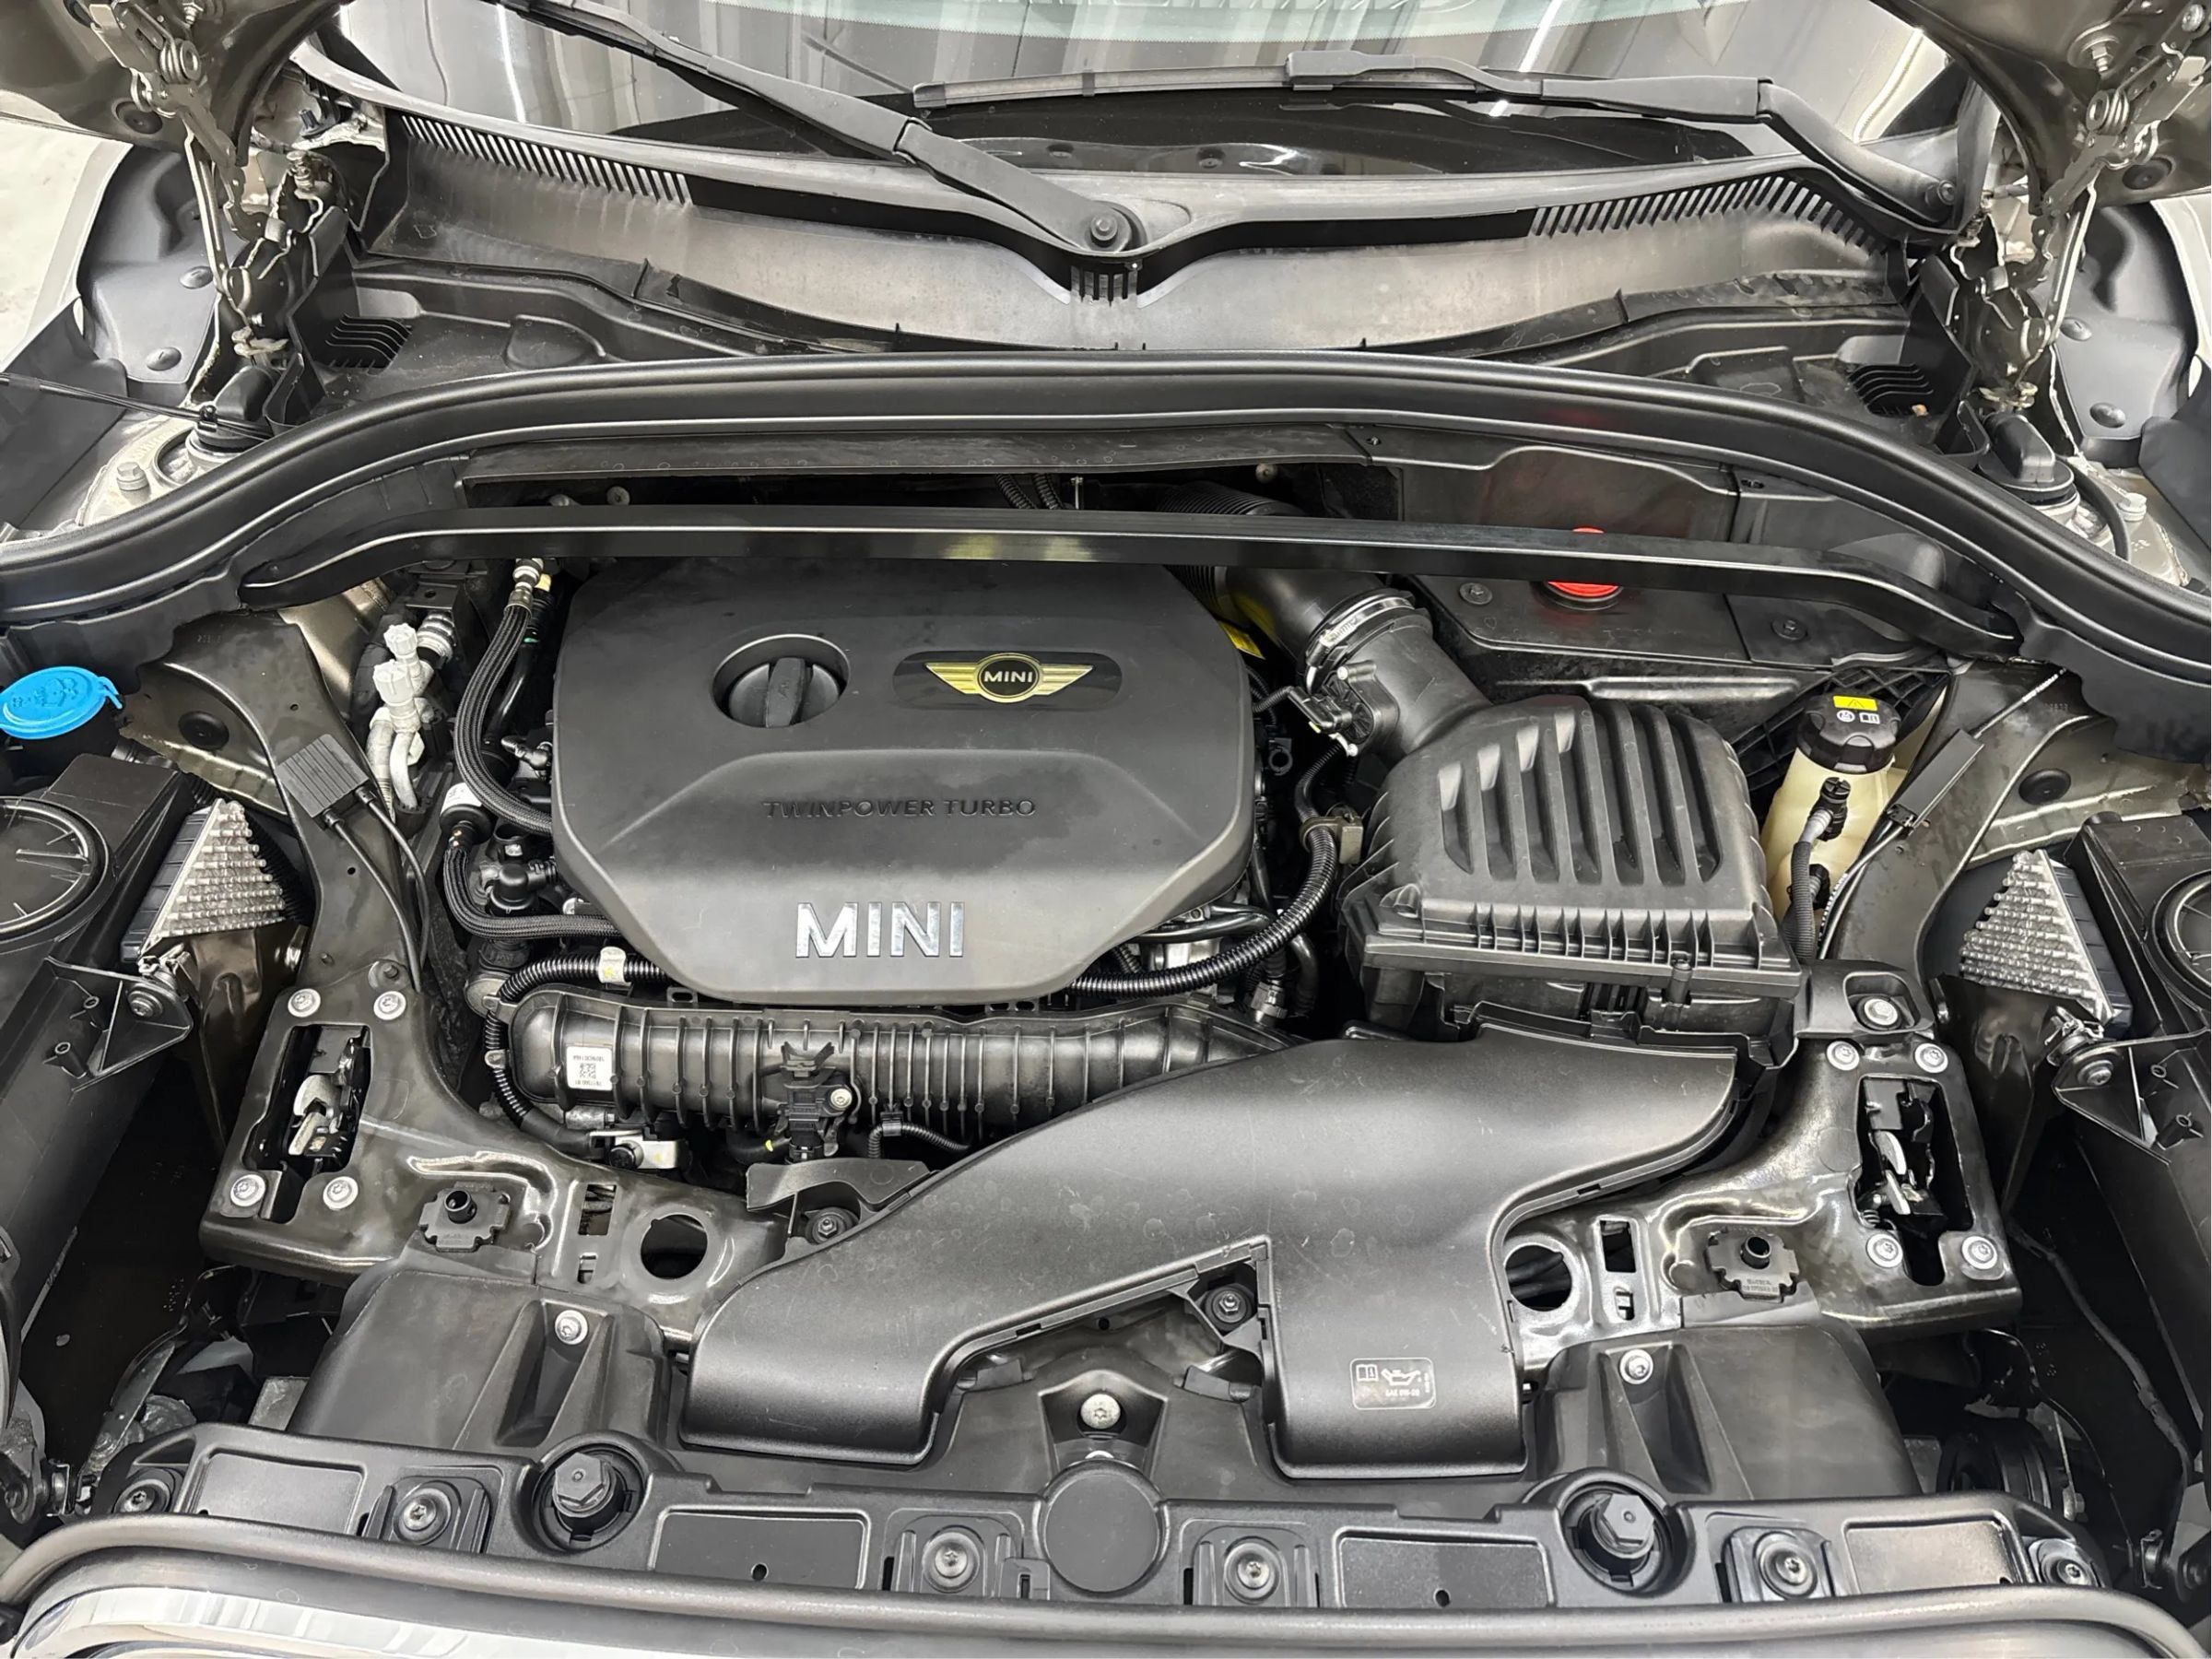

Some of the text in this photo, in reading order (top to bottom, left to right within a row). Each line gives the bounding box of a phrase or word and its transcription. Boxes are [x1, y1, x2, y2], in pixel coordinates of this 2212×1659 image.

[983, 670, 1033, 683] MINI
[763, 800, 1037, 818] TWINPOWER TURBO
[795, 901, 965, 959] MINI
